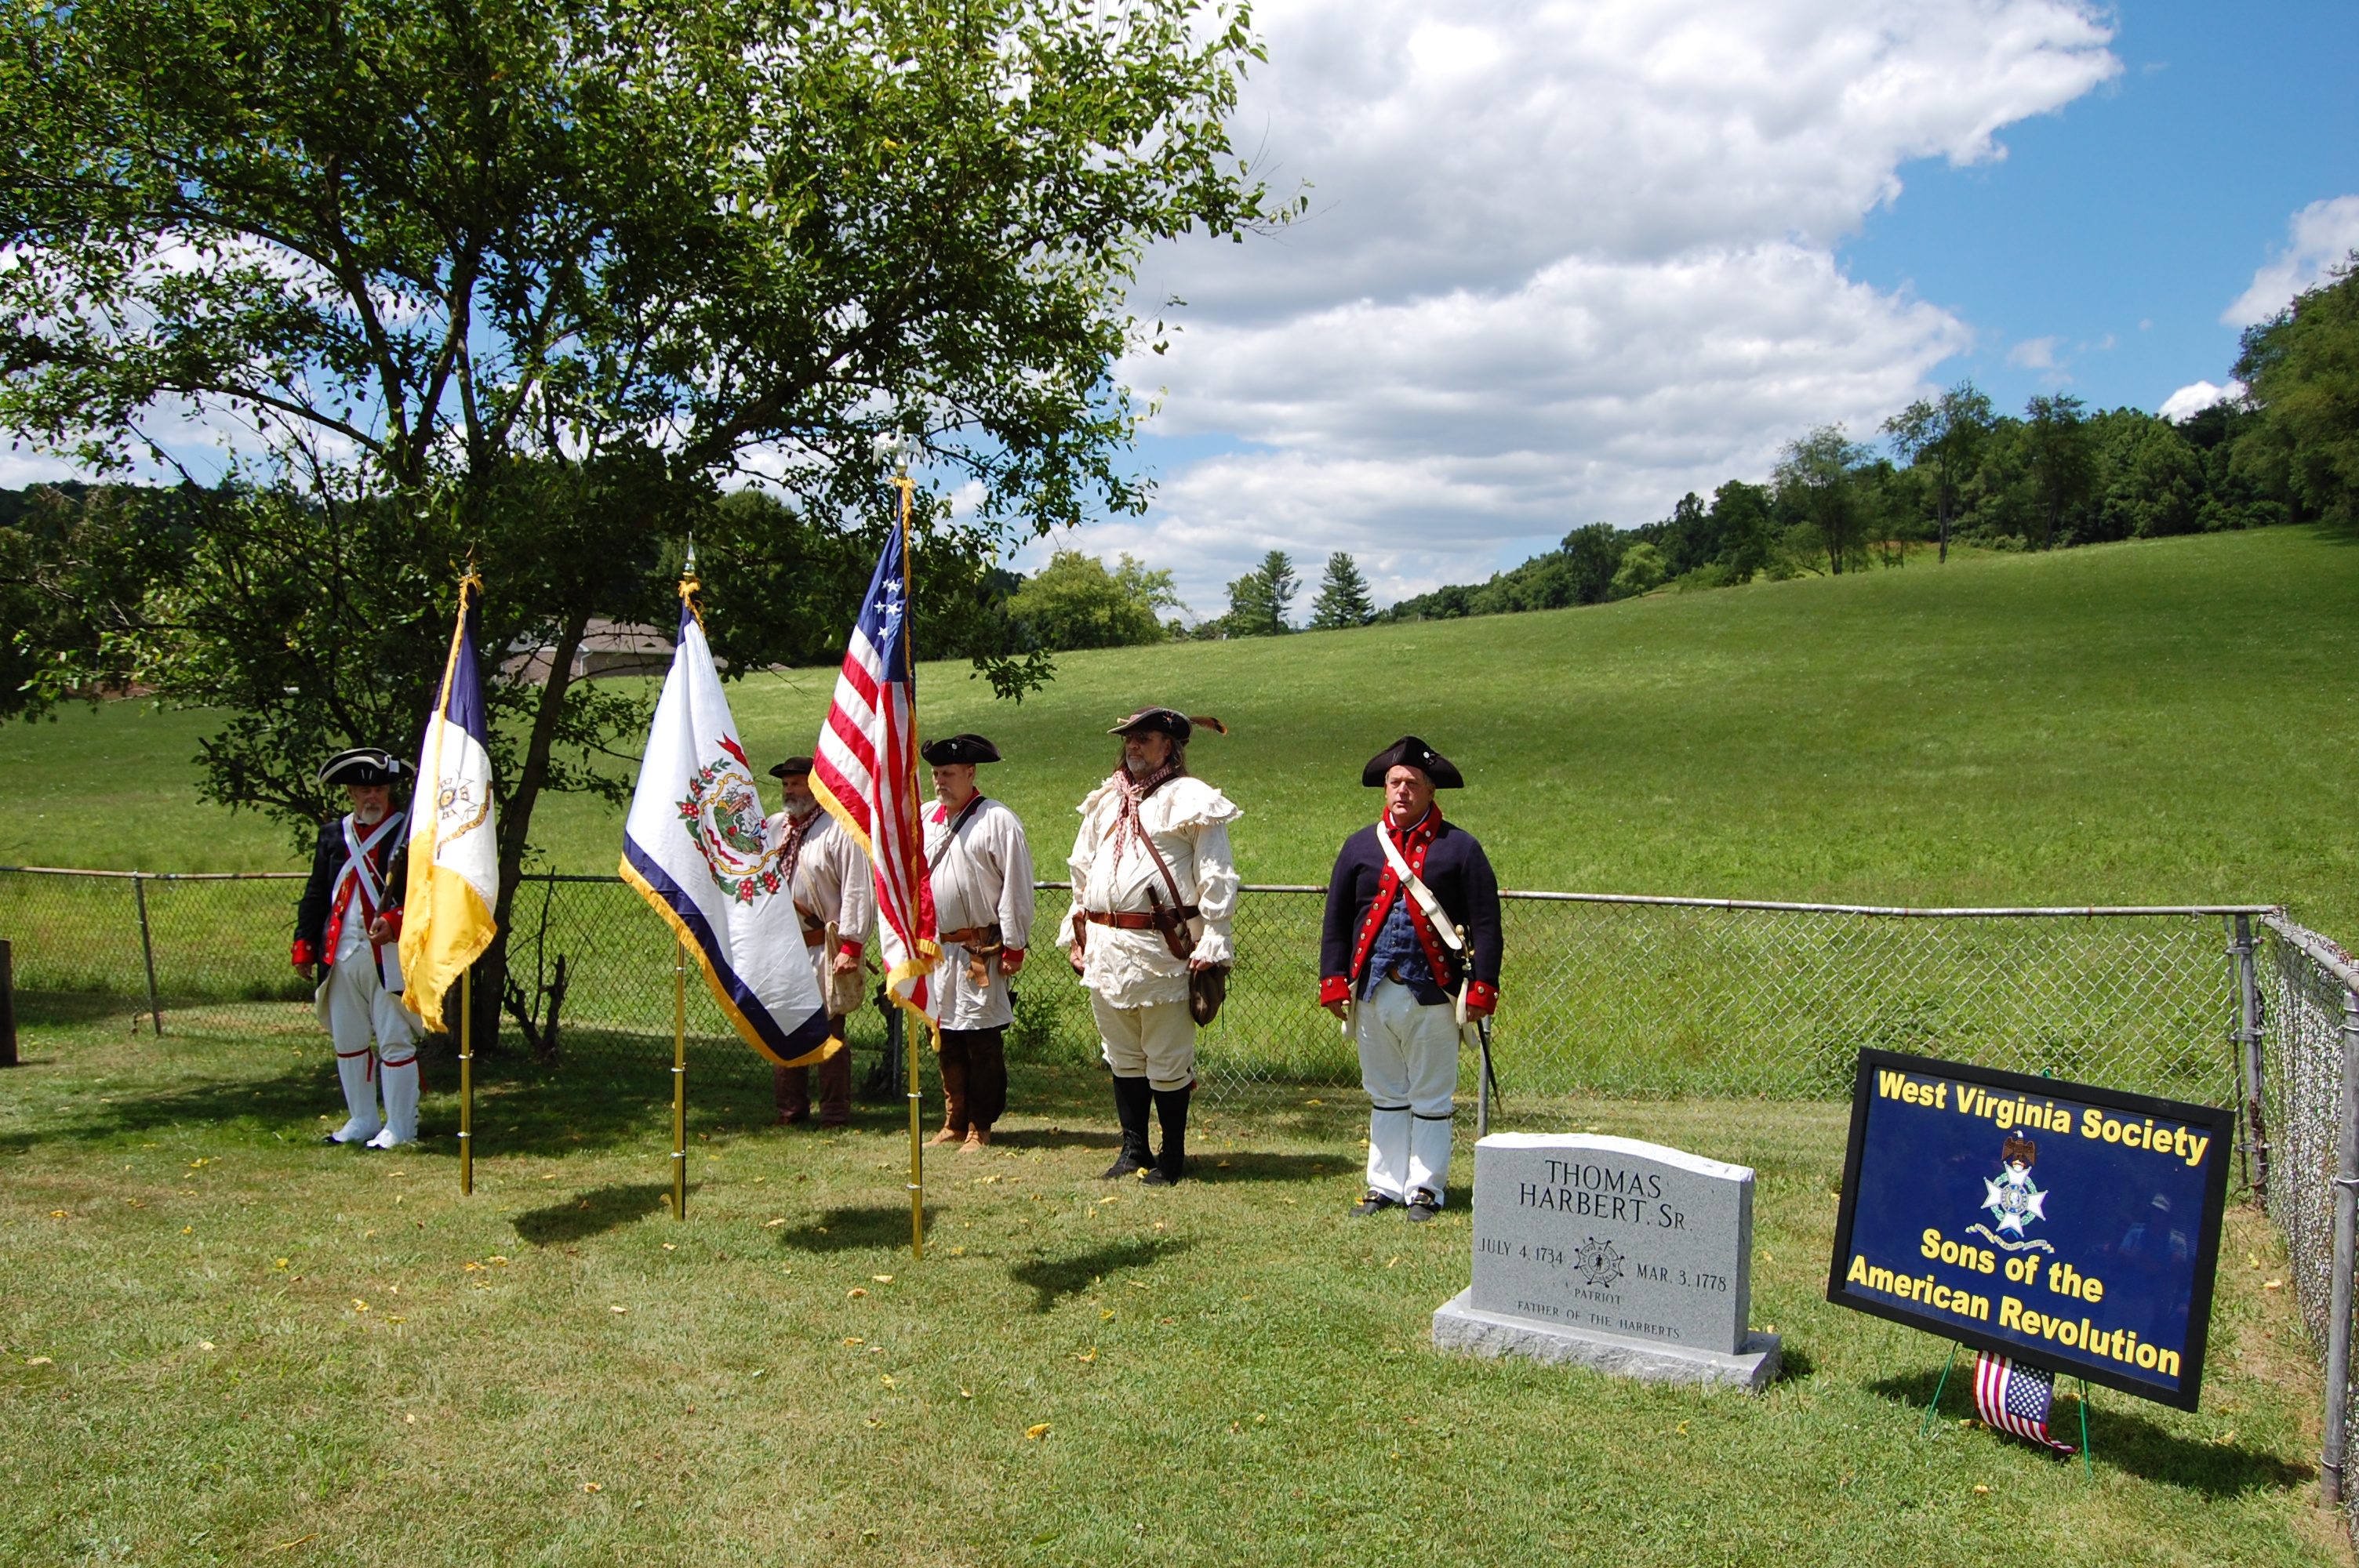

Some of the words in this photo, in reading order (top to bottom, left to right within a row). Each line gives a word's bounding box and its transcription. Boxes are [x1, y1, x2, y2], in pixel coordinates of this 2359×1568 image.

[1879, 1069, 1947, 1109] West
[1956, 1084, 2071, 1134] Virginia
[2081, 1109, 2209, 1167] Society
[1545, 1160, 1661, 1199] THOMAS
[1478, 1238, 1511, 1256] JULY
[1536, 1247, 1563, 1265] 1734
[1921, 1228, 1995, 1274] Sons
[2005, 1254, 2040, 1285] of
[2048, 1261, 2103, 1303] the
[1637, 1262, 1673, 1283] MAR.
[1696, 1273, 1726, 1292] 1778
[1575, 1288, 1622, 1305] PATRIOT
[1846, 1254, 1990, 1321] American
[1999, 1295, 2180, 1377] Revolution
[1518, 1301, 1559, 1317] FATHER
[1566, 1308, 1580, 1320] OF
[1590, 1313, 1612, 1327] THE
[1619, 1319, 1680, 1339] HARBERTS
